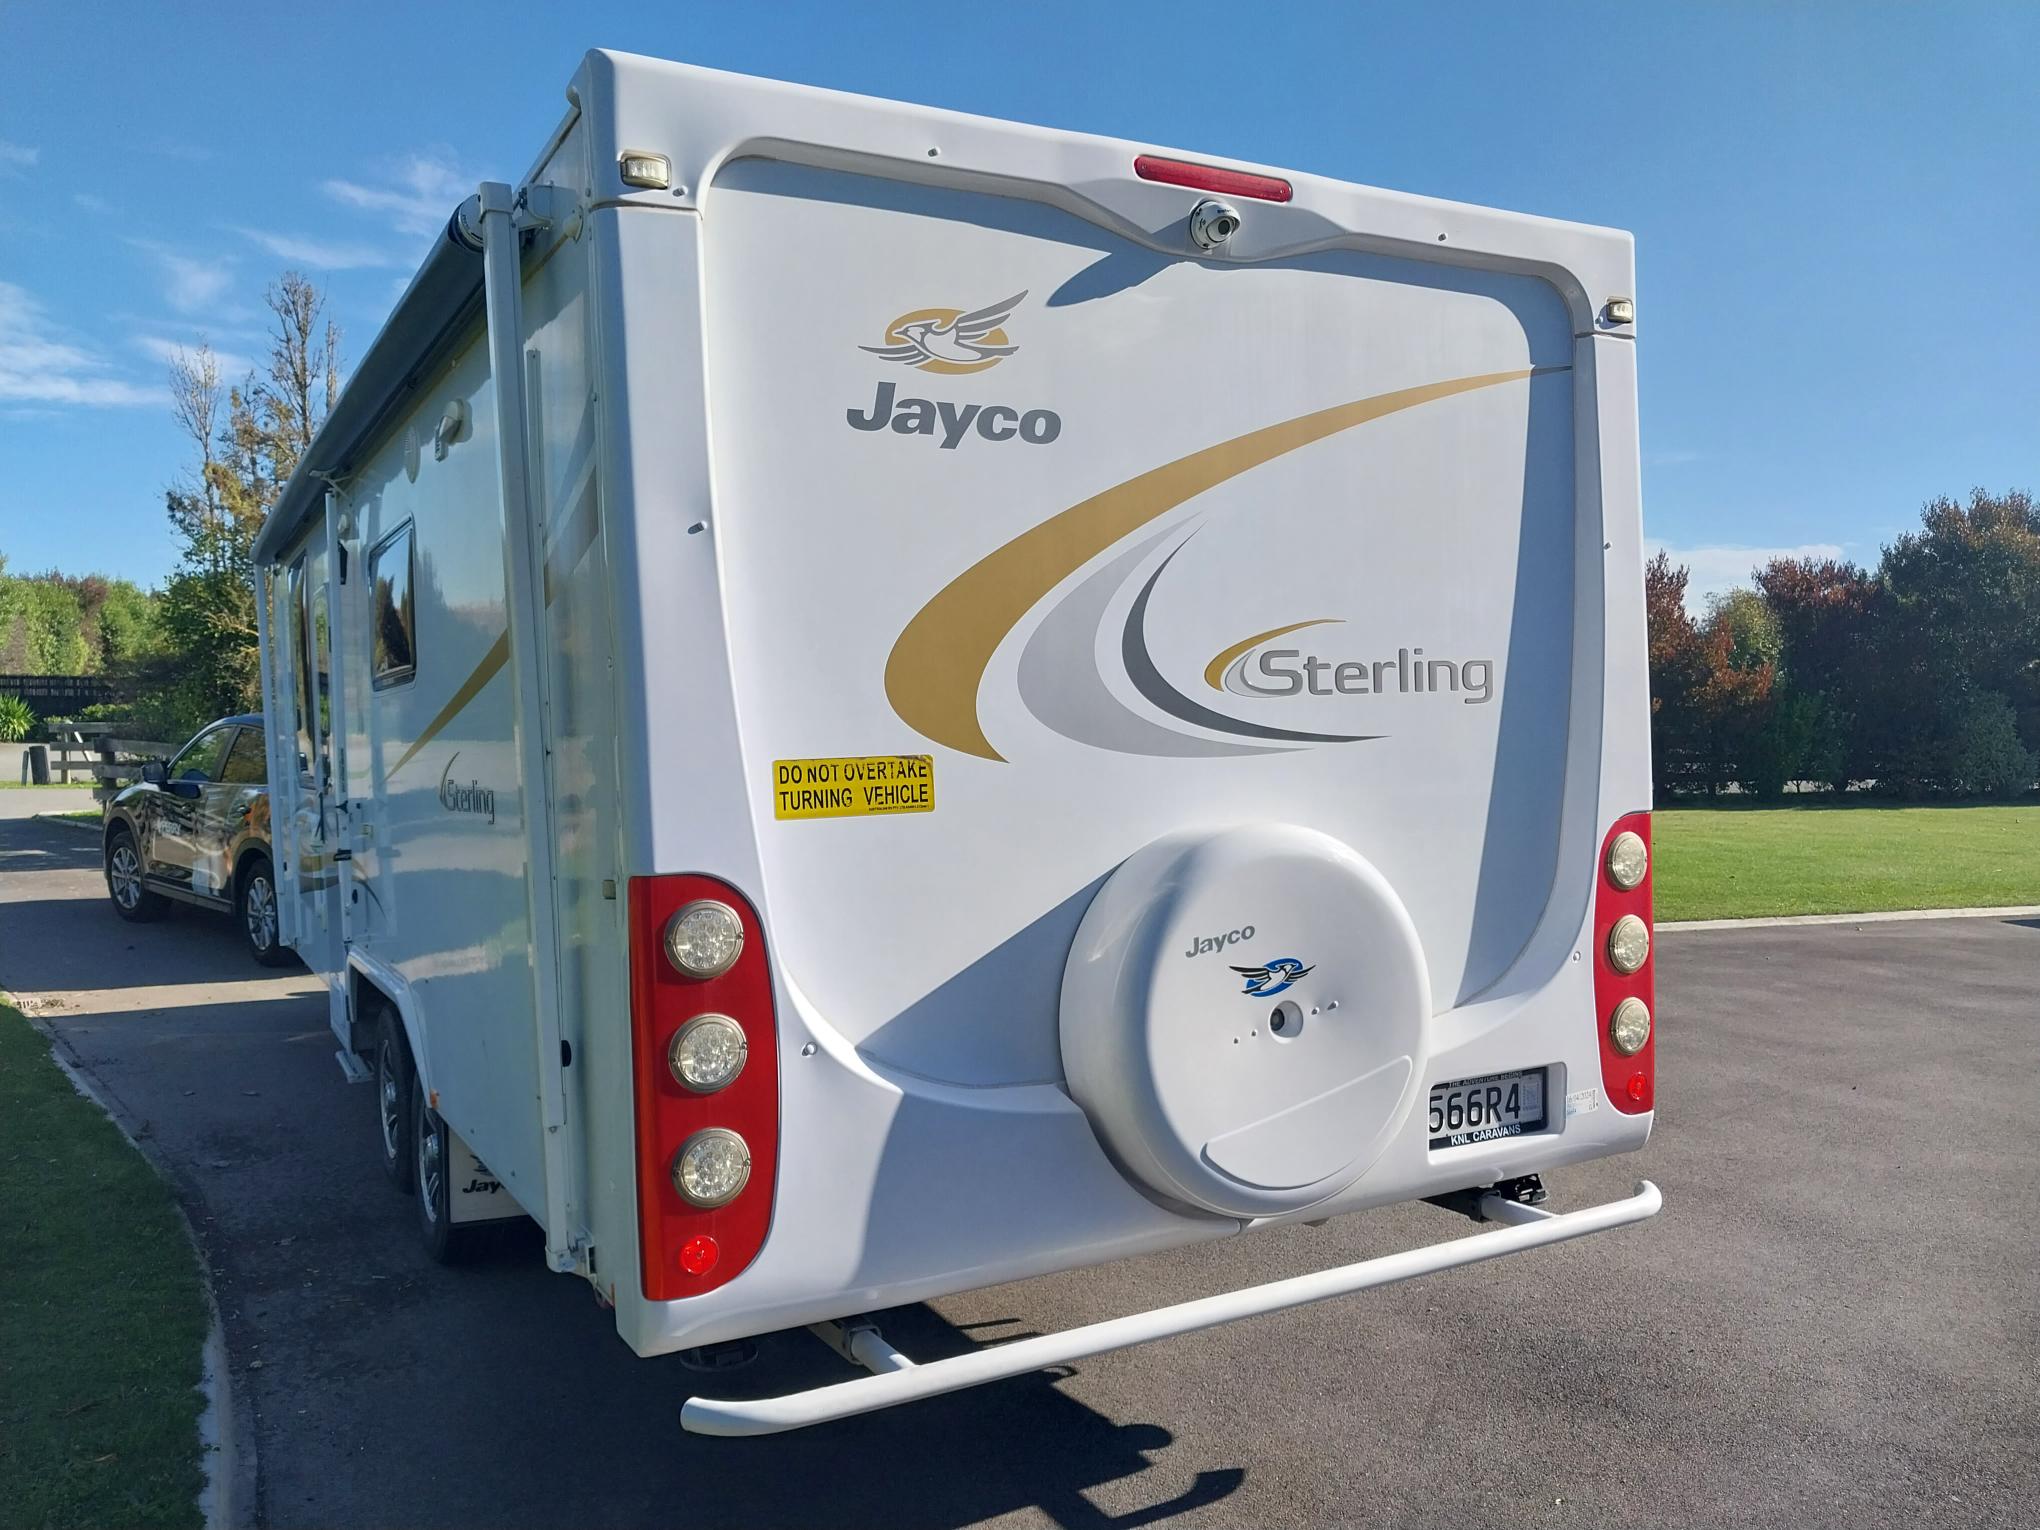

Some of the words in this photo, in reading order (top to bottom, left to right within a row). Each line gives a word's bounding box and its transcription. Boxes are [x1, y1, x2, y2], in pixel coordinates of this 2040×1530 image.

[846, 380, 1062, 450] Jayco
[1258, 647, 1494, 704] Sterling
[779, 765, 803, 784] DO
[807, 764, 839, 783] NOT
[844, 759, 928, 782] OVERTAKE
[446, 779, 495, 825] Sterling
[779, 787, 853, 811] TURNING
[863, 783, 929, 805] VEHICLE
[1185, 925, 1256, 958] Jayco
[1450, 1131, 1471, 1146] KNL
[1472, 1123, 1521, 1142] CARAVANS
[462, 1179, 507, 1194] Jay
